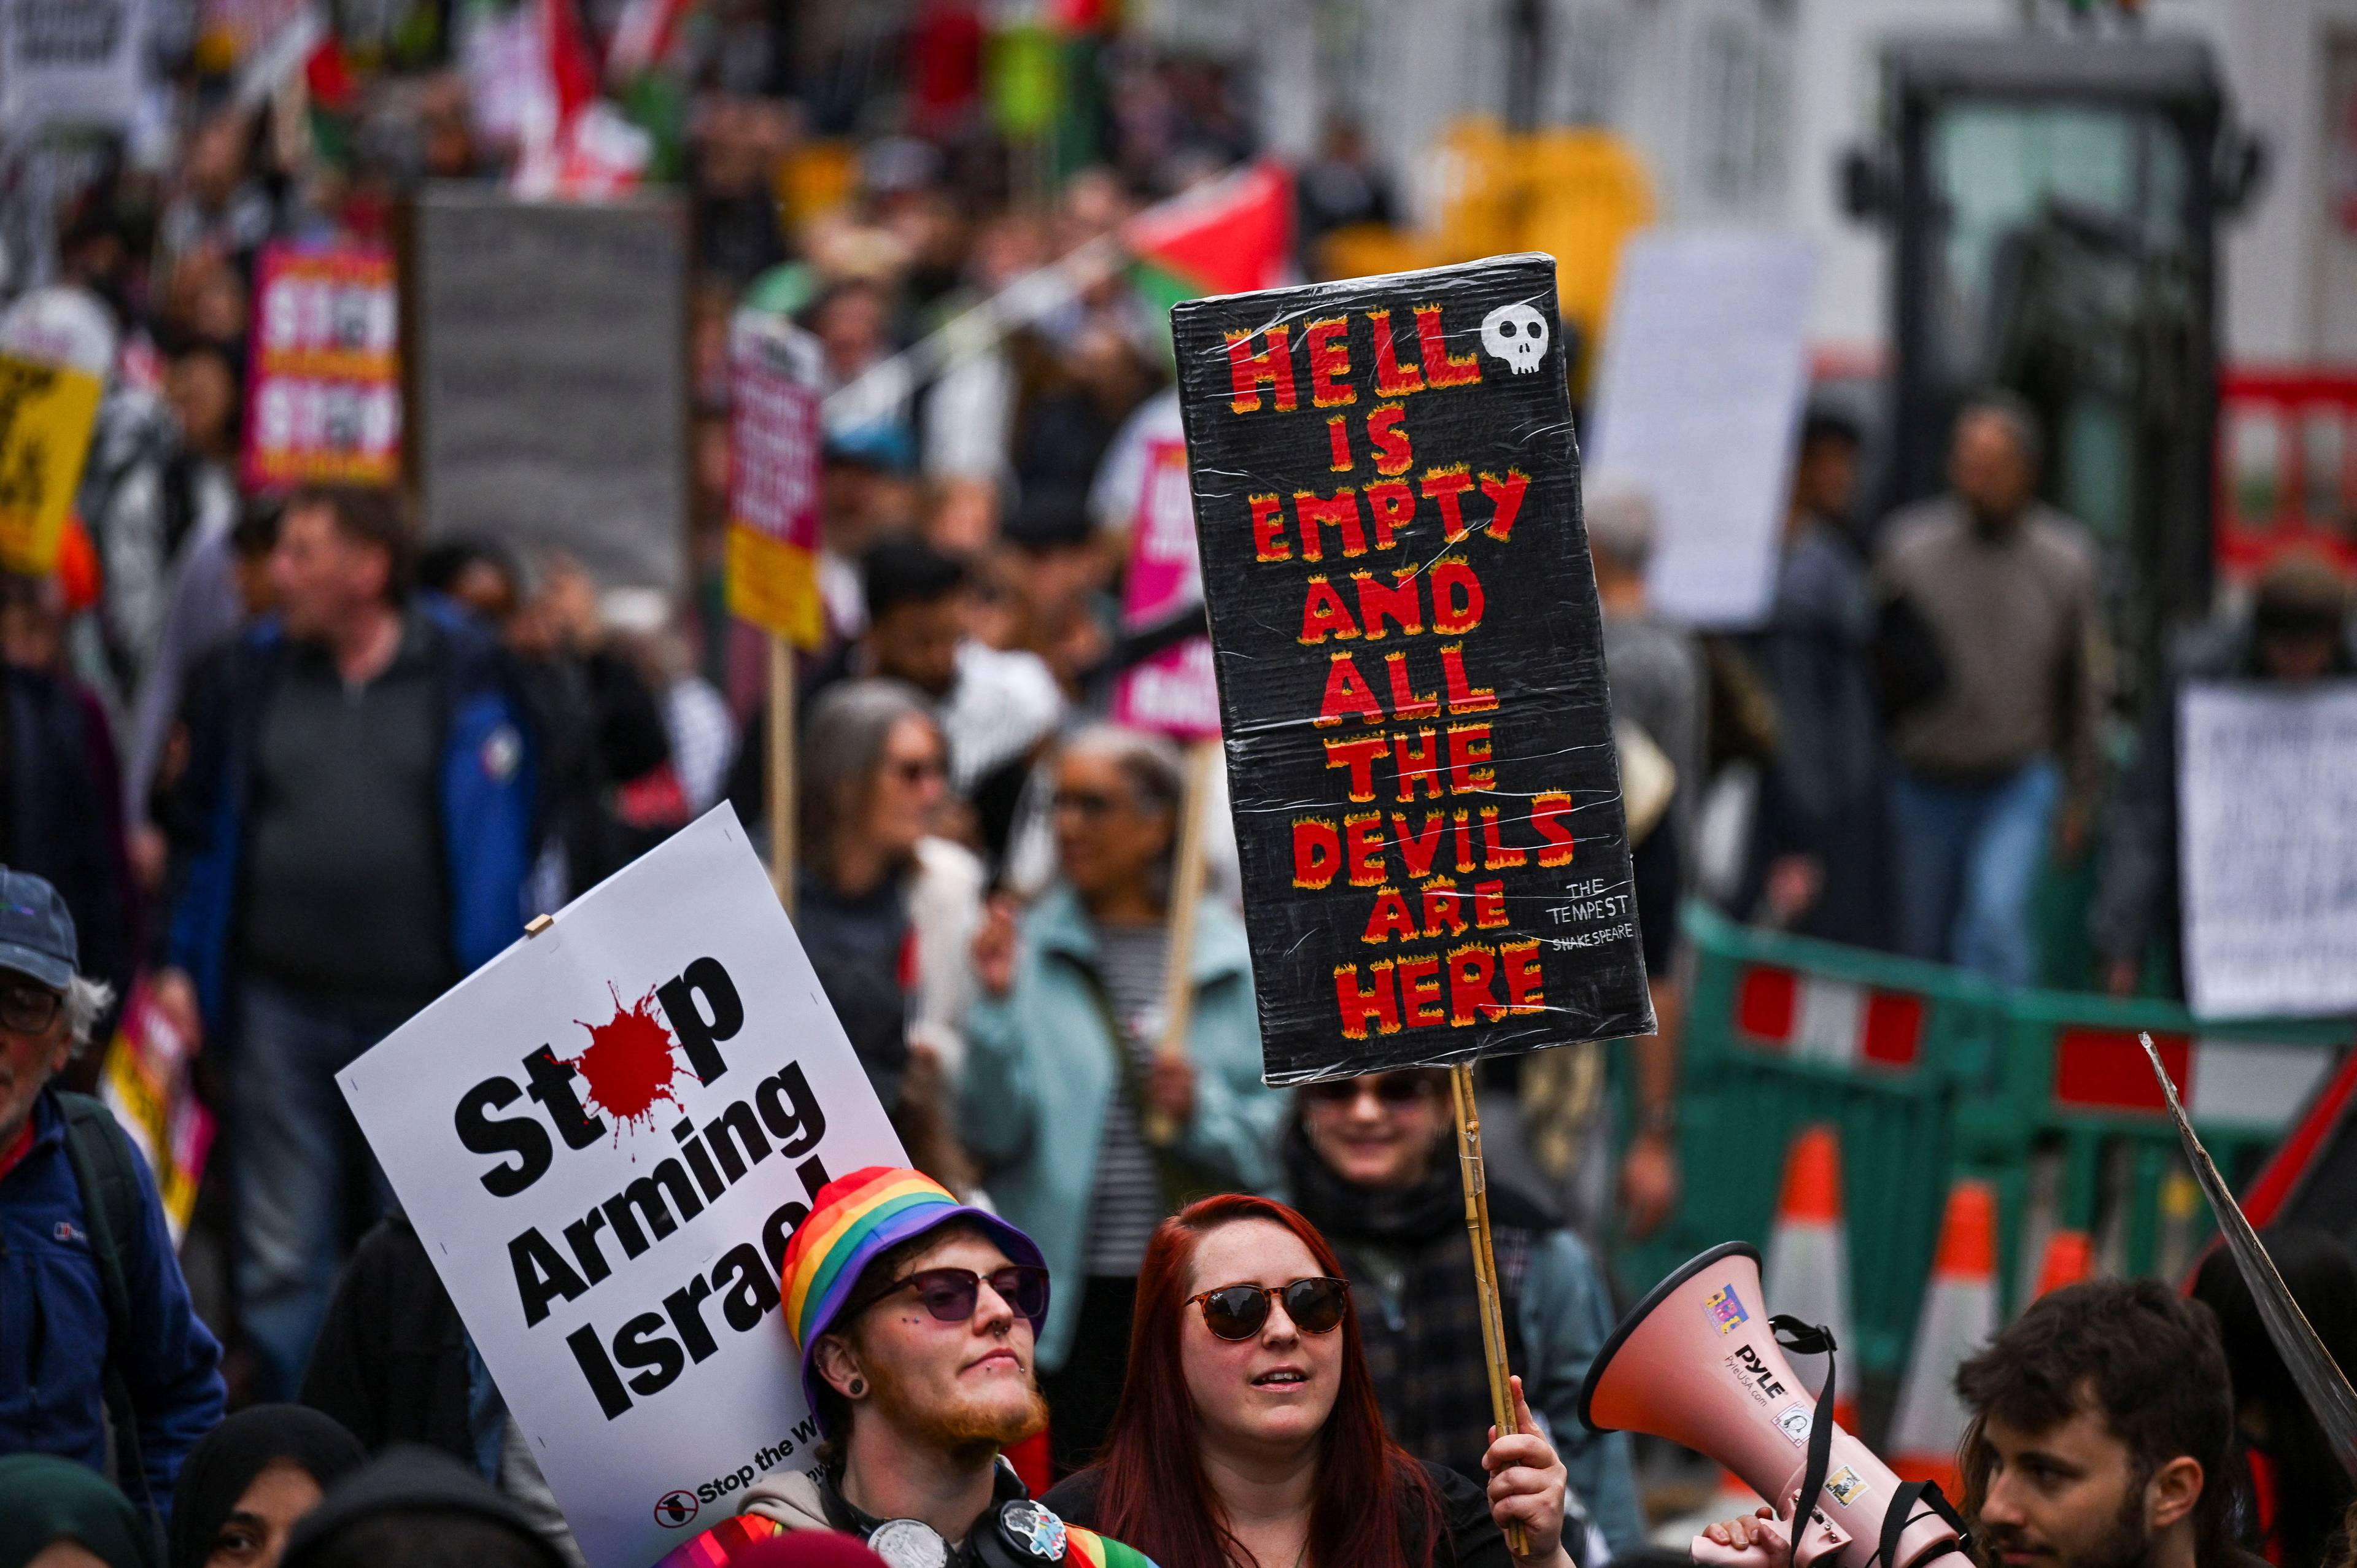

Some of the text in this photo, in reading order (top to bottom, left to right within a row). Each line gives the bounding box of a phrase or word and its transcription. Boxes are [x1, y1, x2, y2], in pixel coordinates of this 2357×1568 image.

[1224, 303, 1482, 414] HELL
[1326, 400, 1414, 476] IS
[1248, 462, 1532, 563] EMPTY
[1297, 555, 1485, 646] AND
[1312, 641, 1500, 729] ALL
[1323, 722, 1498, 803] THE
[1291, 787, 1575, 890] DEVILS
[1360, 874, 1510, 944] ARE
[1545, 895, 1628, 925] TEMPEST
[1566, 879, 1604, 897] THE
[1552, 923, 1635, 951] SHAKESPEARE
[1333, 938, 1546, 1041] HERE
[507, 1060, 826, 1329] Arming
[1724, 1354, 1768, 1408] PyleUSA.com
[1735, 1344, 1785, 1399] PYLE
[697, 1464, 755, 1504] Stop
[754, 1439, 794, 1472] the
